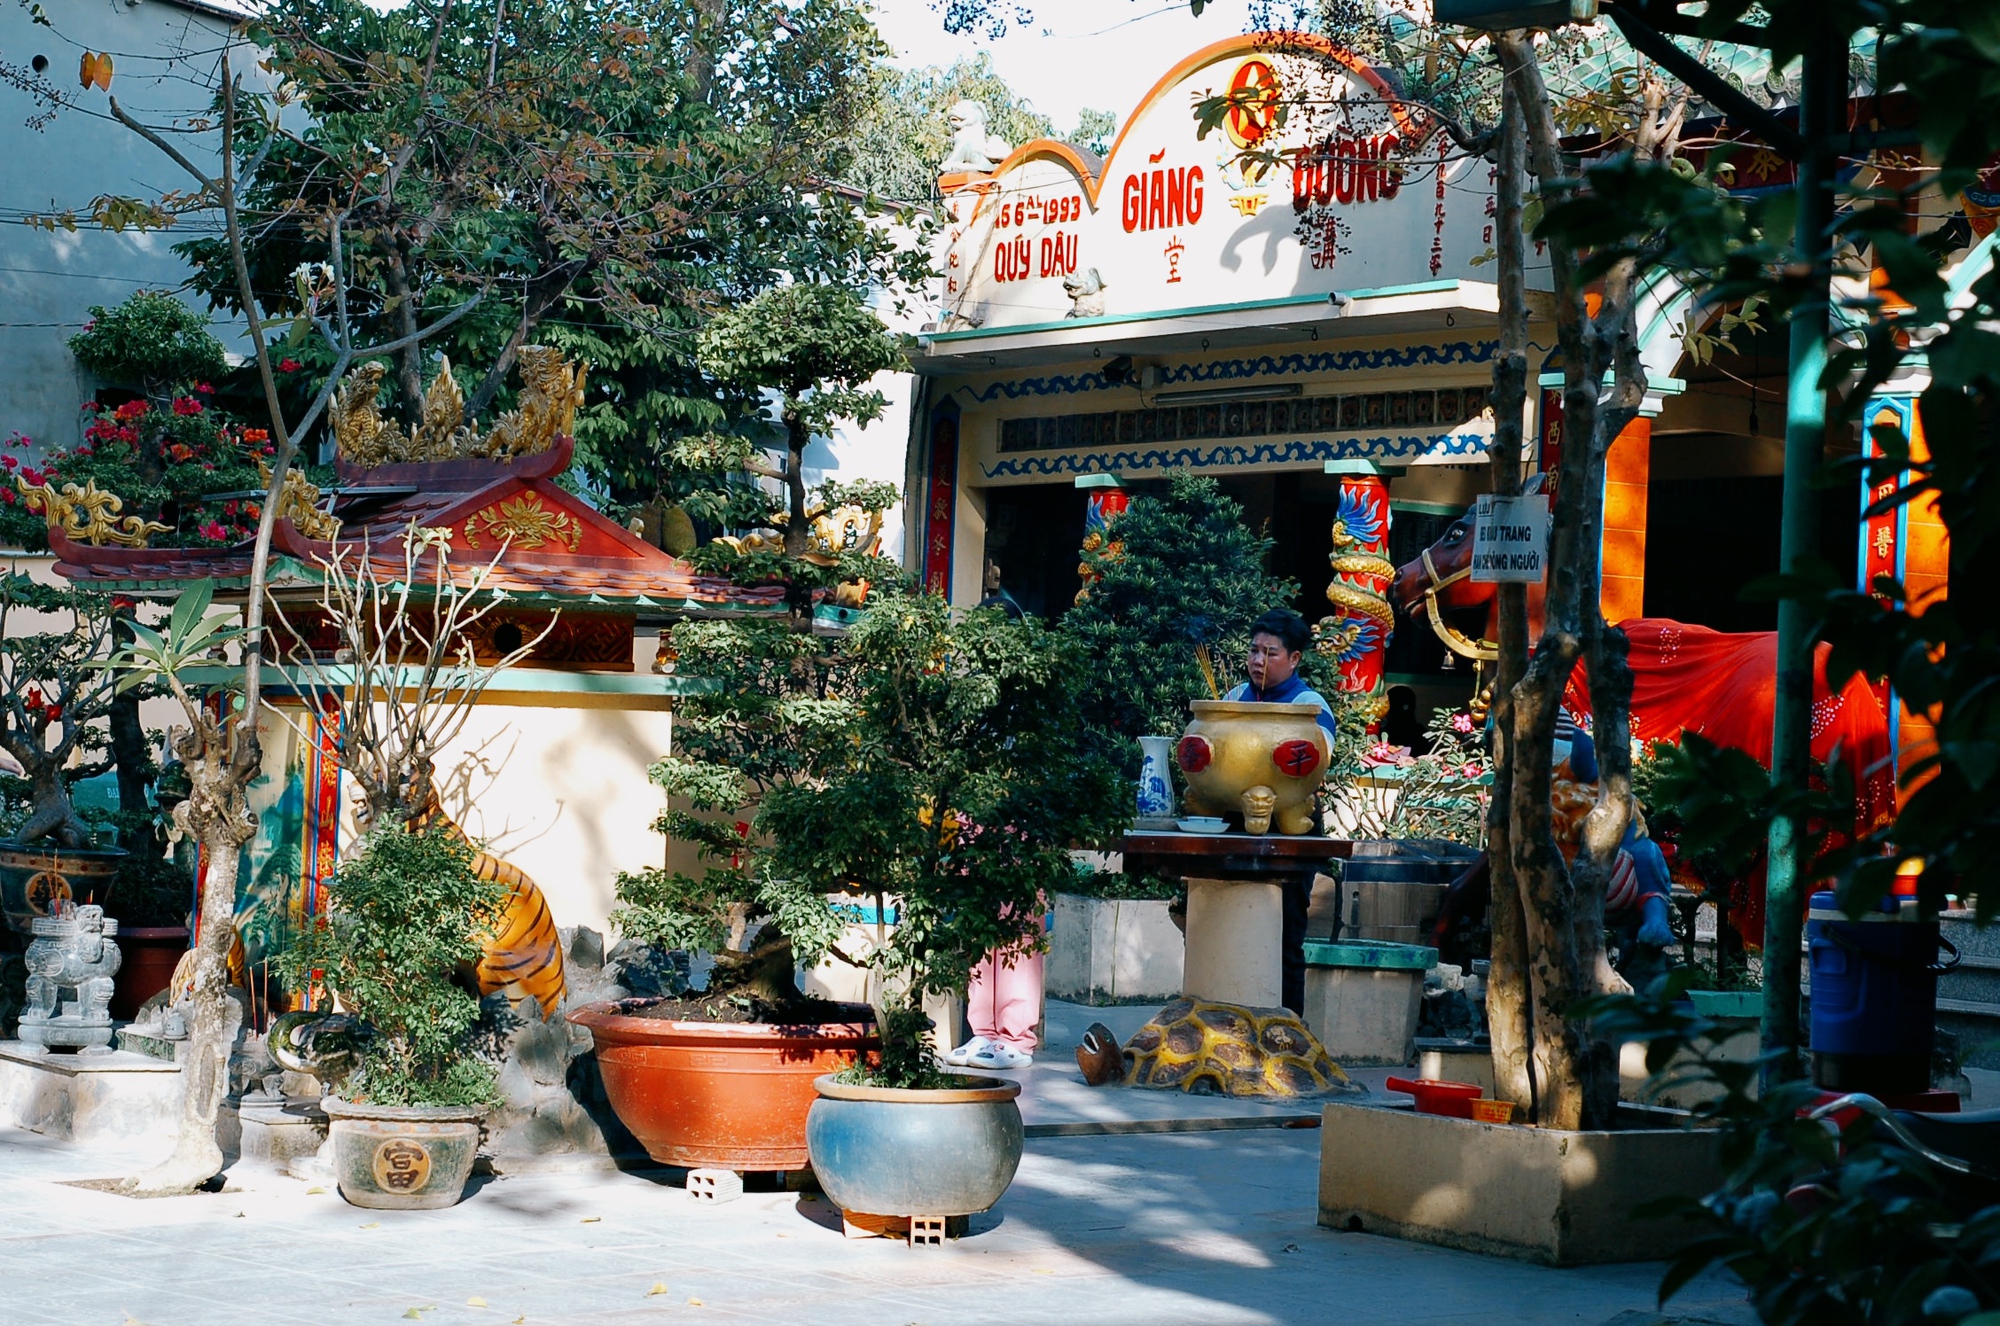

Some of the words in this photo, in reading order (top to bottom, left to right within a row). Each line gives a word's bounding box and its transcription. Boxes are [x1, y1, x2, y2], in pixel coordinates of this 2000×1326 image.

[1122, 147, 1204, 233] GIÃNG
[994, 233, 1031, 283] QUÝ
[1164, 235, 1185, 283] 堂
[1500, 525, 1532, 542] TRANG
[1510, 550, 1540, 570] NGƯỜI
